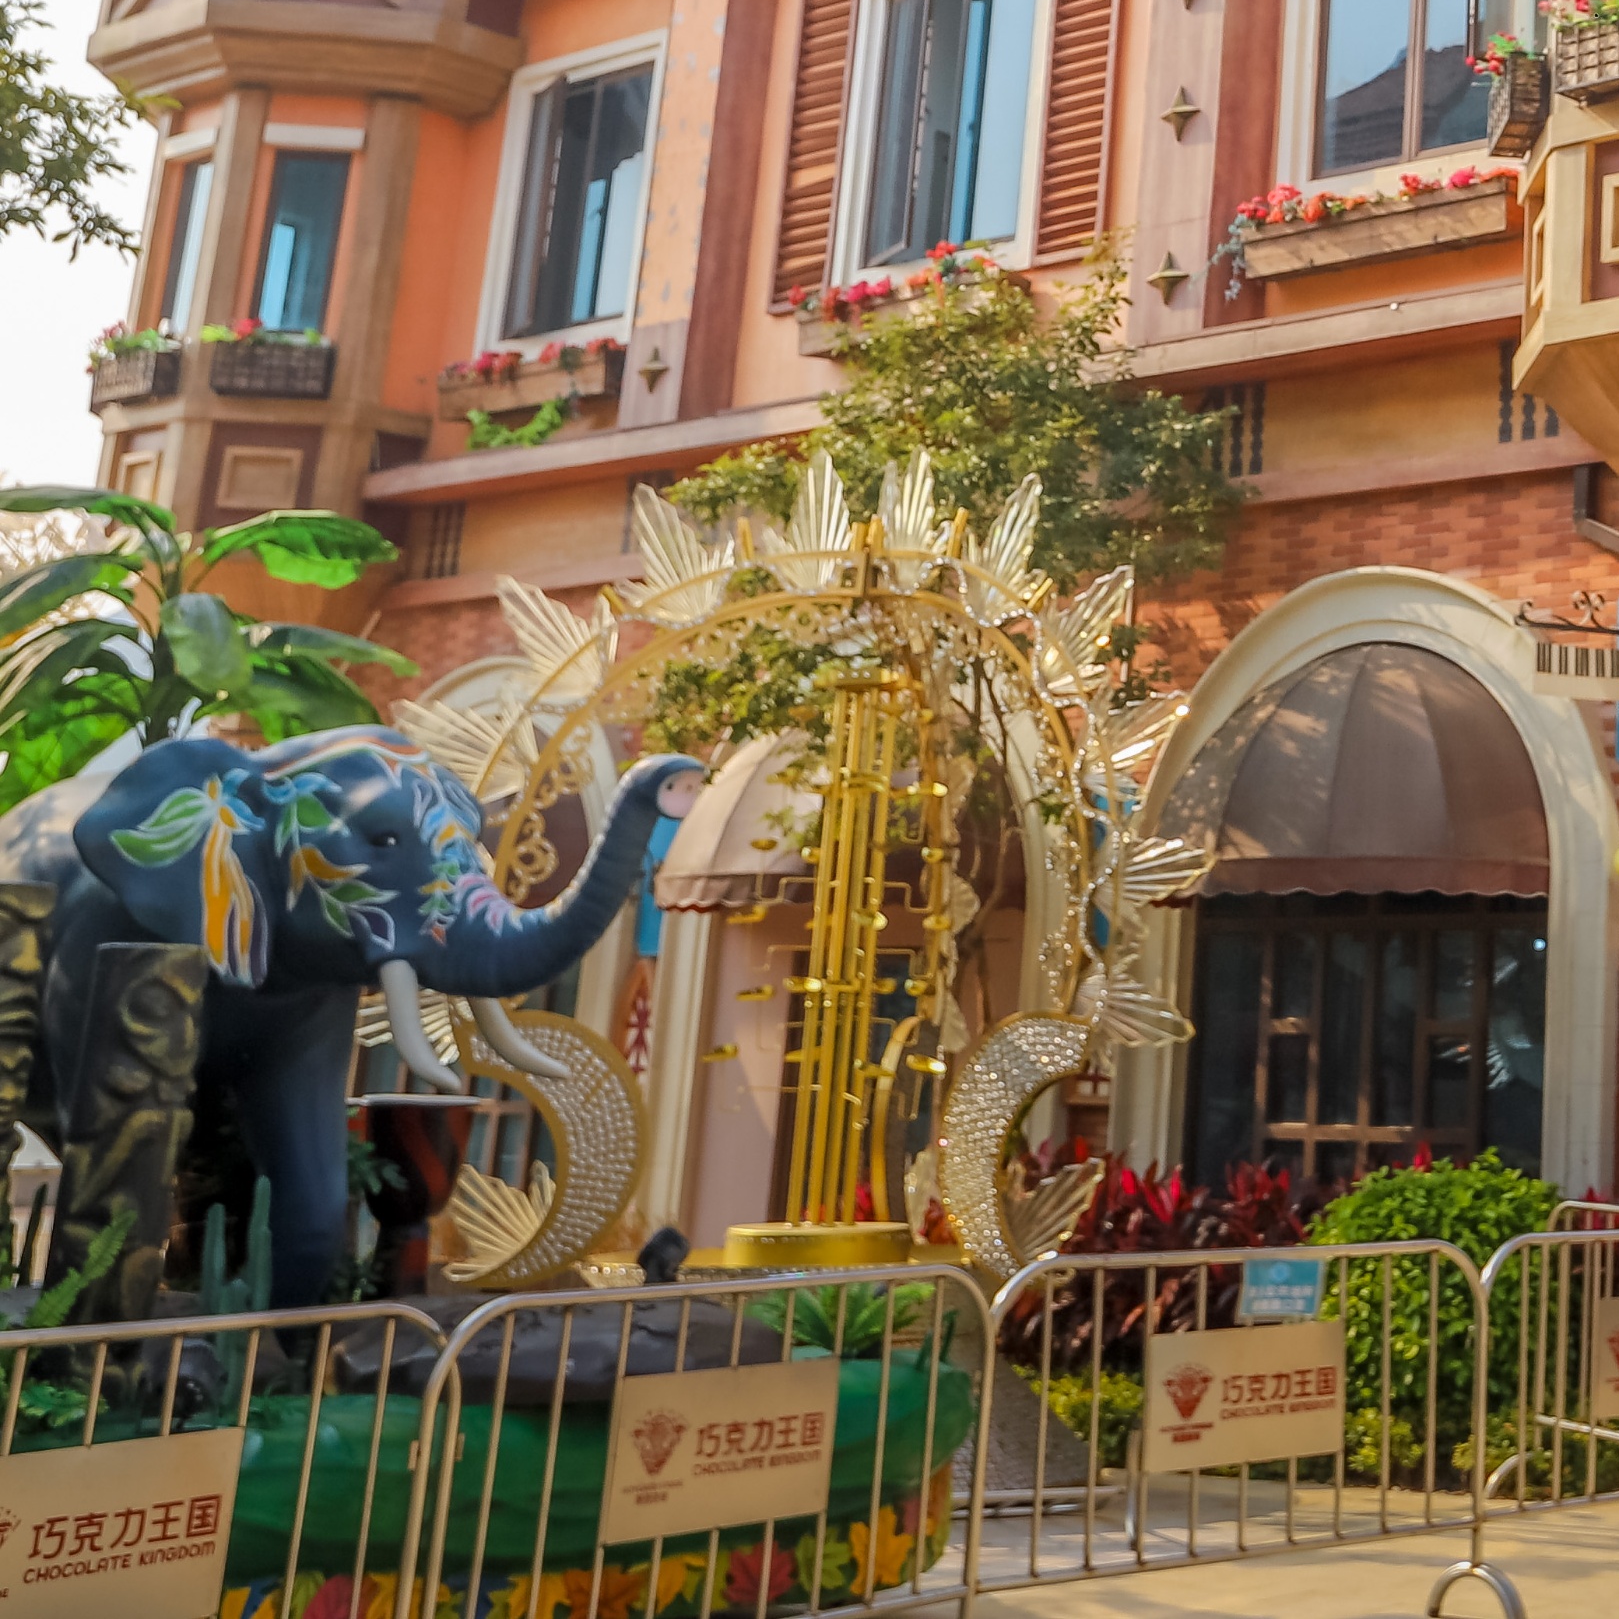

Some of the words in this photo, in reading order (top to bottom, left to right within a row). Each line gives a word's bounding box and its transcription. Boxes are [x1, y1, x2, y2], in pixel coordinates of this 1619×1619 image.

[1221, 1365, 1336, 1403] 巧克力王国
[695, 1412, 824, 1457] 巧克力王国
[28, 1494, 221, 1559] 巧克力王国
[23, 1553, 132, 1584] CHOCOLATE
[139, 1540, 216, 1566] KINGDOM
